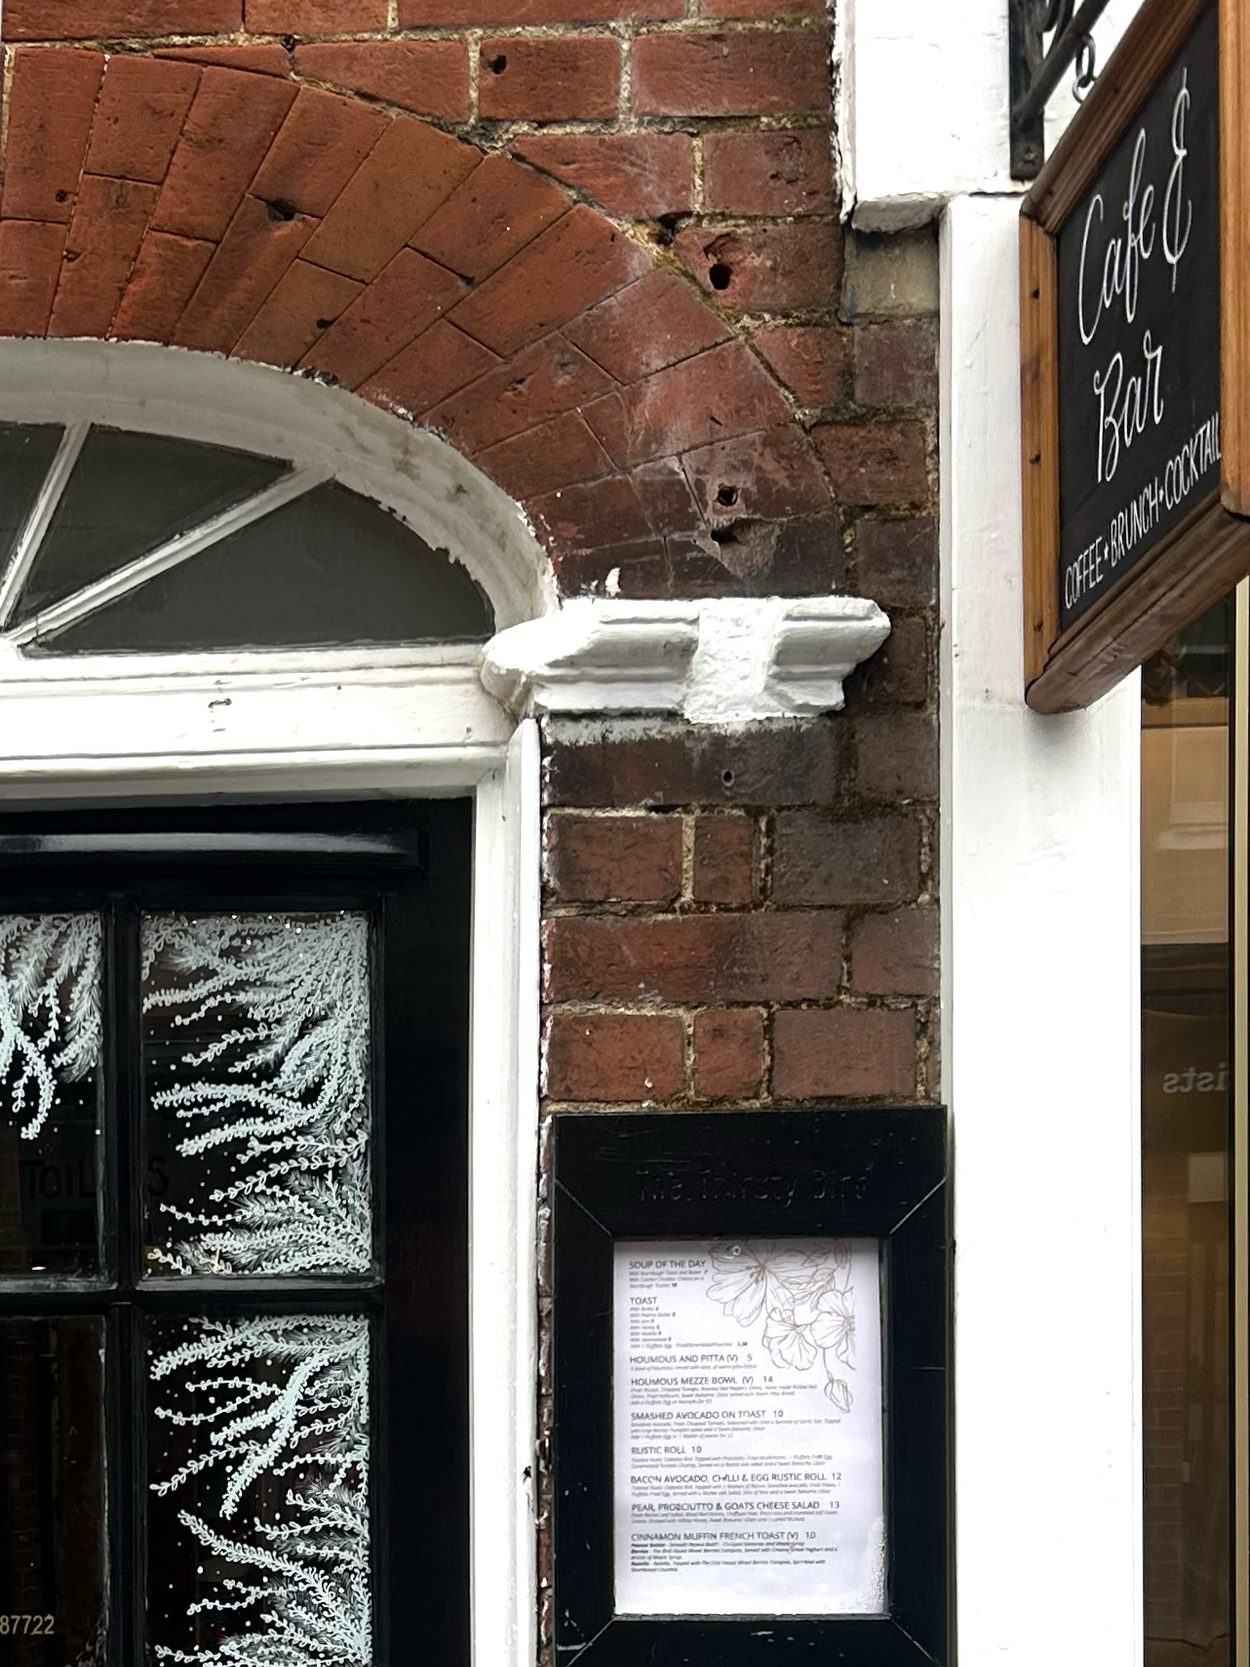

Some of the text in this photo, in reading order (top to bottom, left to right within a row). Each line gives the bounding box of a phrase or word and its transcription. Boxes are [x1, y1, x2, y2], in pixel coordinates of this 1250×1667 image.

[1079, 127, 1156, 345] Cafe
[1093, 329, 1164, 483] Bar
[1064, 535, 1104, 609] COFFEE
[1110, 476, 1160, 567] BRUNCH
[629, 1259, 707, 1269] SOUP OF THE DAY
[629, 1296, 658, 1306] TOAST
[629, 1353, 753, 1364] HOUMOUS AND PITTA (V) 5
[631, 1375, 774, 1387] HOUMOUS MEZZE BOWL (V) 14
[630, 1409, 784, 1421] SMASHED AVOCADO ON TOAST 10
[630, 1445, 703, 1456] RUSTIC ROLL 10
[630, 1475, 662, 1485] BACON
[711, 1474, 740, 1483] CHILLI
[741, 1473, 749, 1482] &
[750, 1473, 770, 1482] EGG
[771, 1472, 803, 1482] RUSTIC
[804, 1472, 828, 1481] ROLL
[831, 1472, 842, 1481] 12
[657, 1502, 714, 1512] PROSCIUTTO
[715, 1502, 723, 1511] &
[756, 1501, 790, 1511] CHEESE
[791, 1500, 820, 1510] SALAD
[829, 1500, 841, 1510] 13
[630, 1531, 817, 1542] CINNAMON MUFFIN FRENCH TOAST (V) 10
